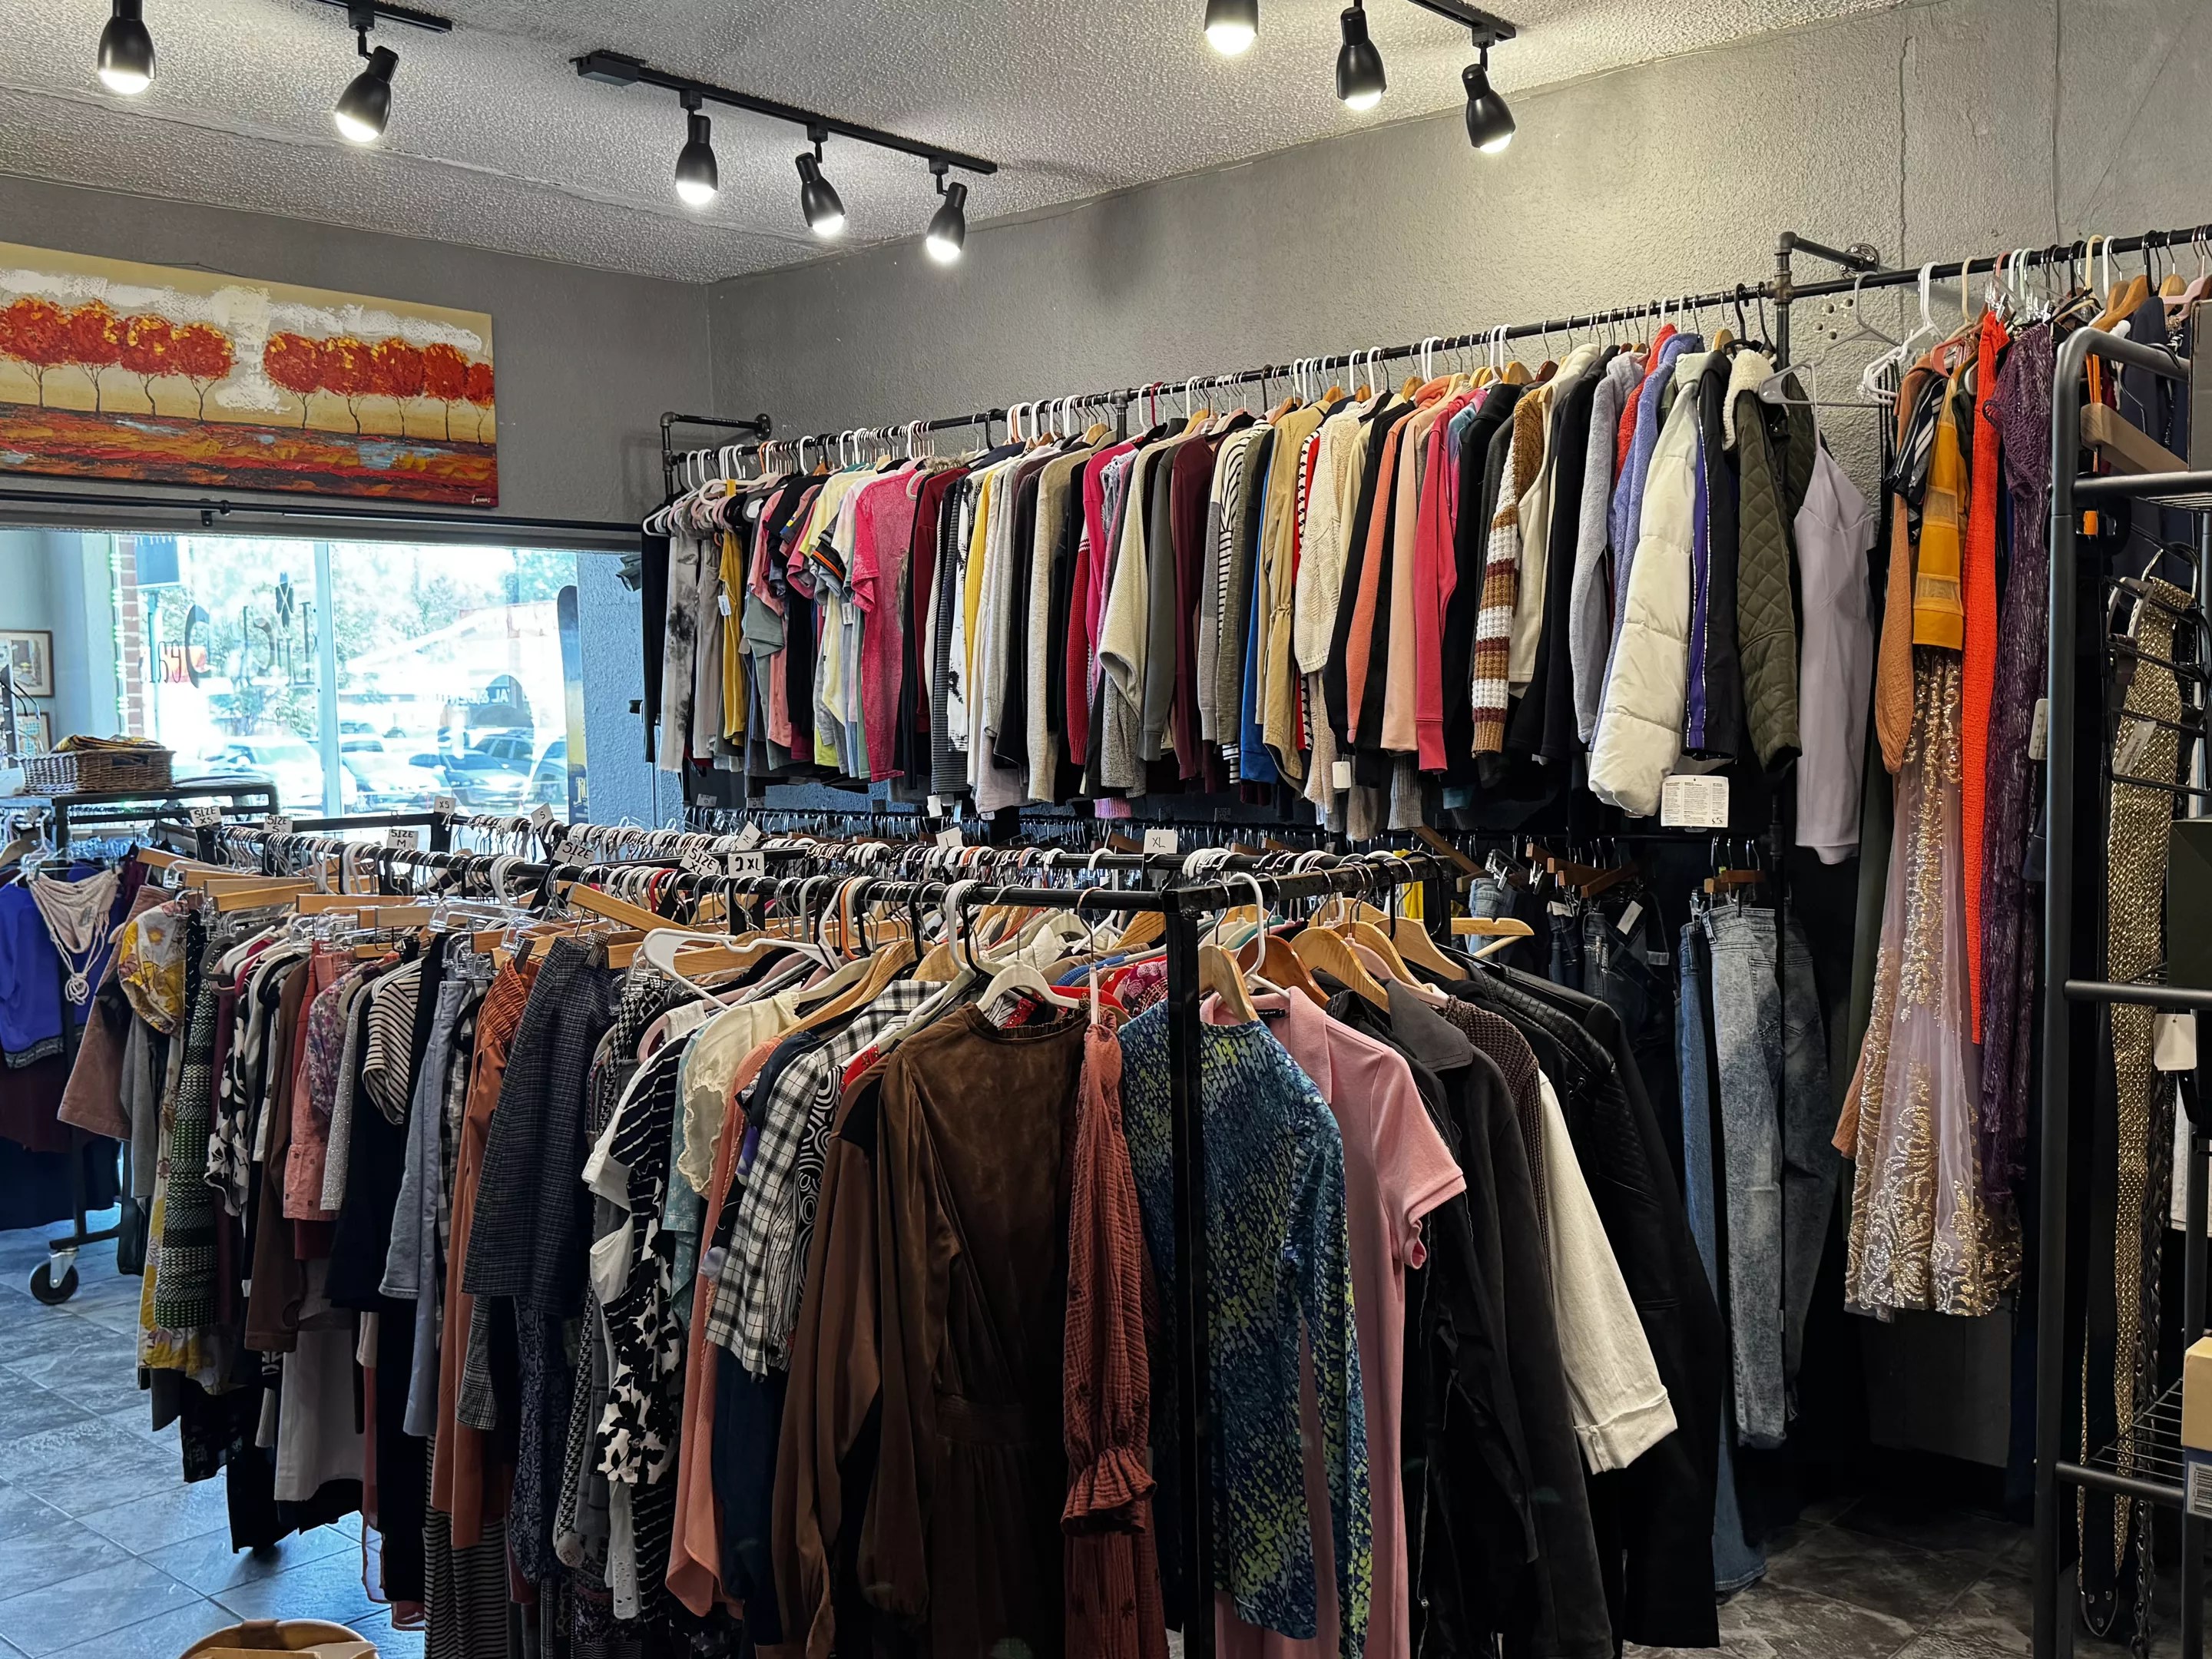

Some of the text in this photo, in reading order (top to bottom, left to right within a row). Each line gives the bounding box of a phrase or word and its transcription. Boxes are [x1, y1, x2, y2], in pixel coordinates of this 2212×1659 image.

[194, 806, 217, 819] SIZE
[539, 811, 546, 820] S
[200, 816, 214, 825] XS
[267, 815, 287, 826] SIZE
[272, 825, 279, 833] S
[391, 829, 414, 838] SIZE
[396, 839, 406, 848] M
[1152, 836, 1166, 848] XL
[562, 842, 594, 859] SIZE
[688, 847, 717, 870] SIZE
[688, 861, 704, 876] XL
